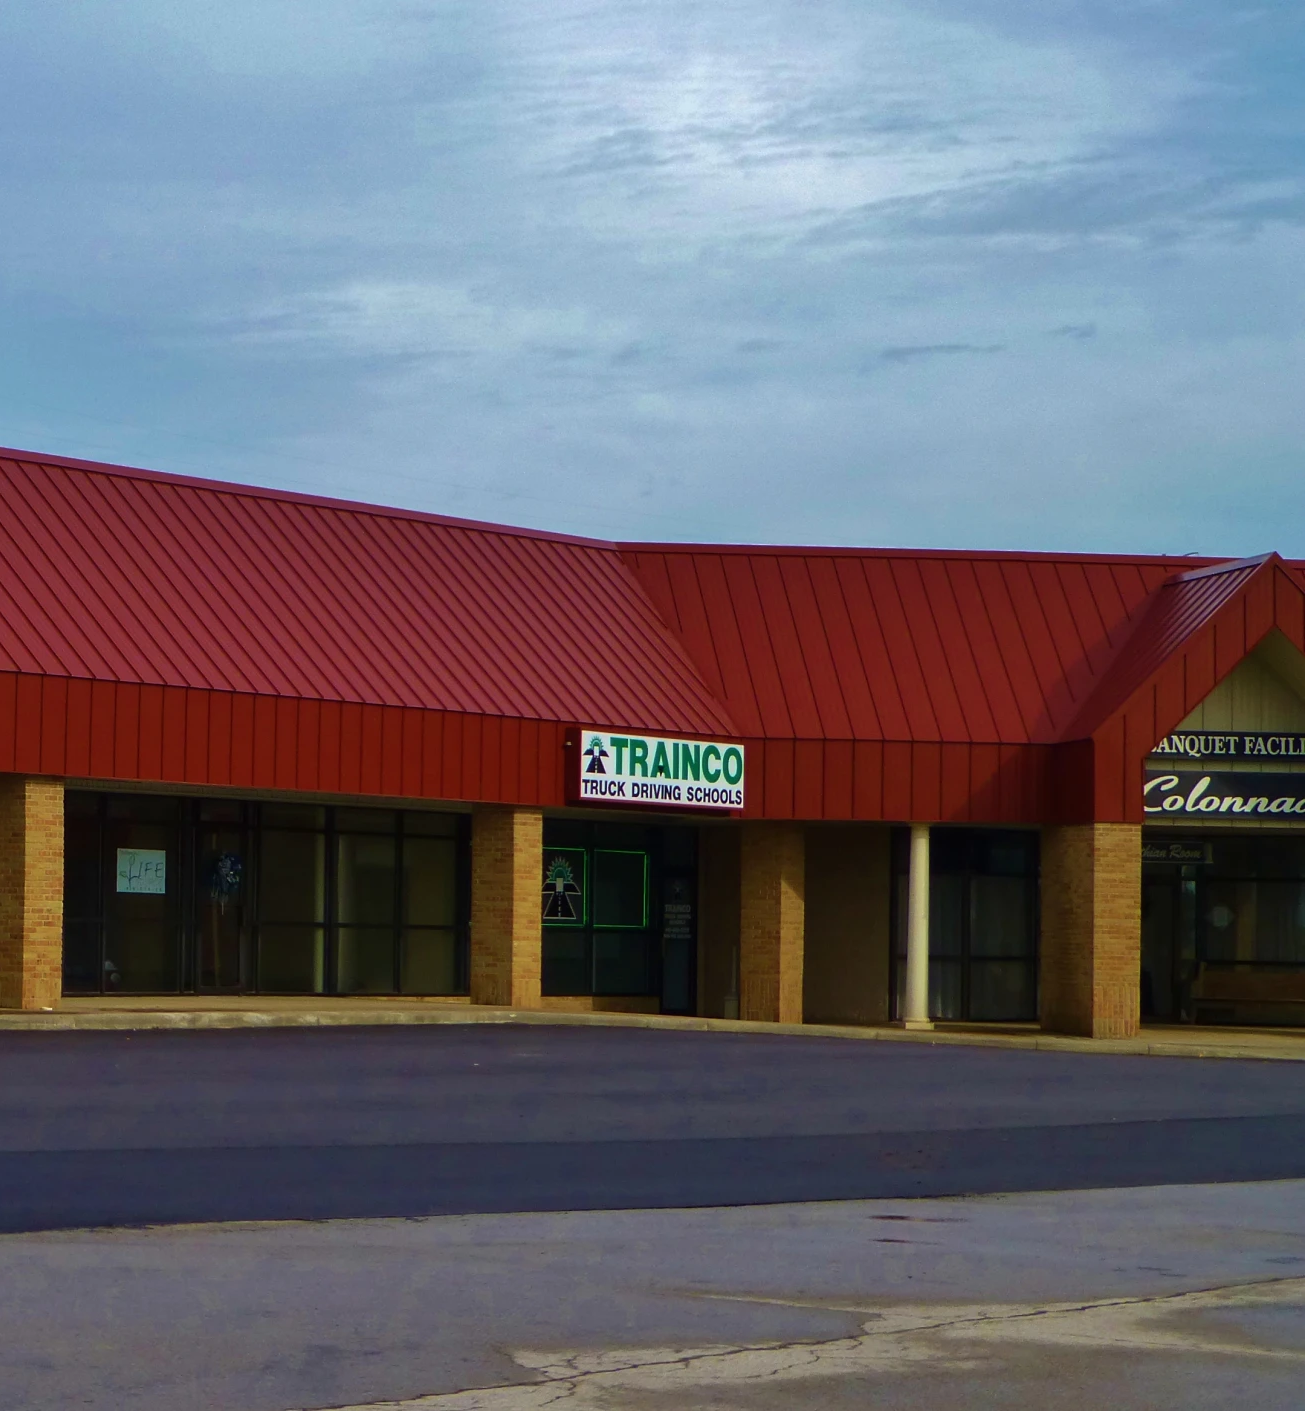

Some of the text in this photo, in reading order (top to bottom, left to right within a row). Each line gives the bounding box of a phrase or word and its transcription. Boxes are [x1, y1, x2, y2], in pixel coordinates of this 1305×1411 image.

[1151, 735, 1239, 757] ANQUET
[609, 736, 743, 786] TRAINCO
[582, 778, 743, 806] TRUCK DRIVING SCHOOLS
[1169, 844, 1201, 859] Room
